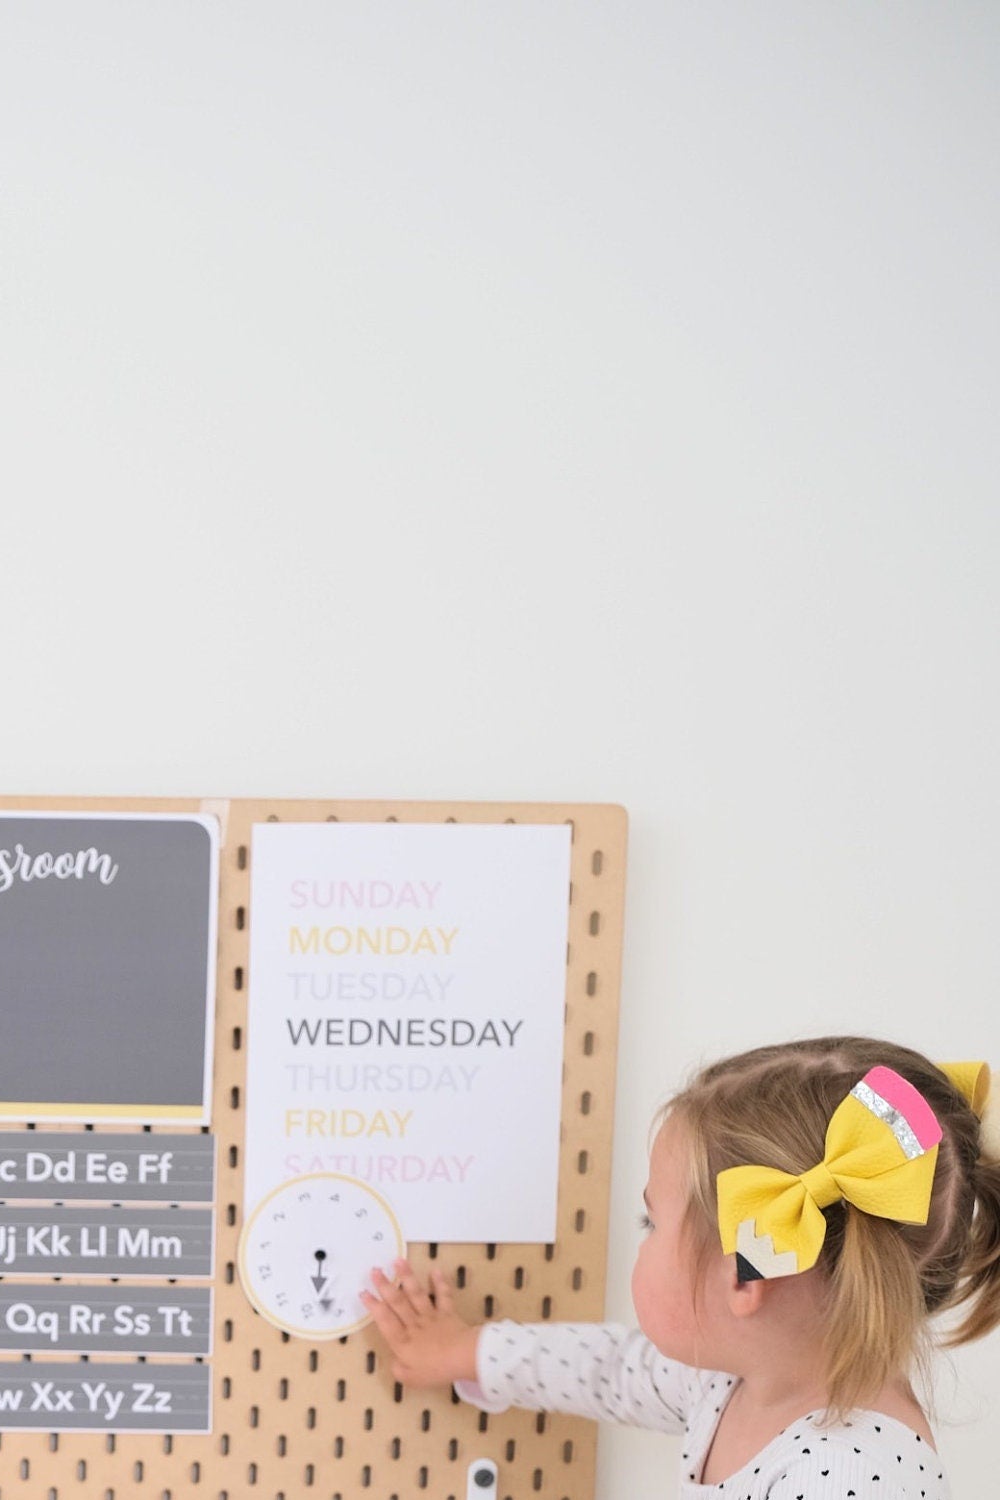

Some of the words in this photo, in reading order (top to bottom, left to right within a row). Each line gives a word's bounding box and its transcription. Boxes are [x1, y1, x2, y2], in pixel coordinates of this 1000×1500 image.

[289, 879, 443, 910] SUNDAY
[288, 926, 460, 955] MONDAY
[287, 972, 456, 1001] TUESDAY
[286, 1019, 523, 1047] WEDNESDAY
[285, 1064, 482, 1092] THURSDAY
[284, 1109, 414, 1137] FRIDAY
[26, 1151, 76, 1183] Dd
[86, 1153, 128, 1184] Ee
[138, 1152, 173, 1184] Ff
[283, 1154, 476, 1183] SATURDAY
[27, 1225, 71, 1257] Kk
[80, 1225, 107, 1257] Ll
[117, 1227, 182, 1258] Mm
[5, 1302, 59, 1342] Qq
[69, 1304, 105, 1335] Rr
[113, 1305, 150, 1336] Ss
[158, 1306, 192, 1336] Tt
[30, 1381, 75, 1412] Xx
[81, 1382, 124, 1420] Yy
[131, 1383, 172, 1413] Zz
